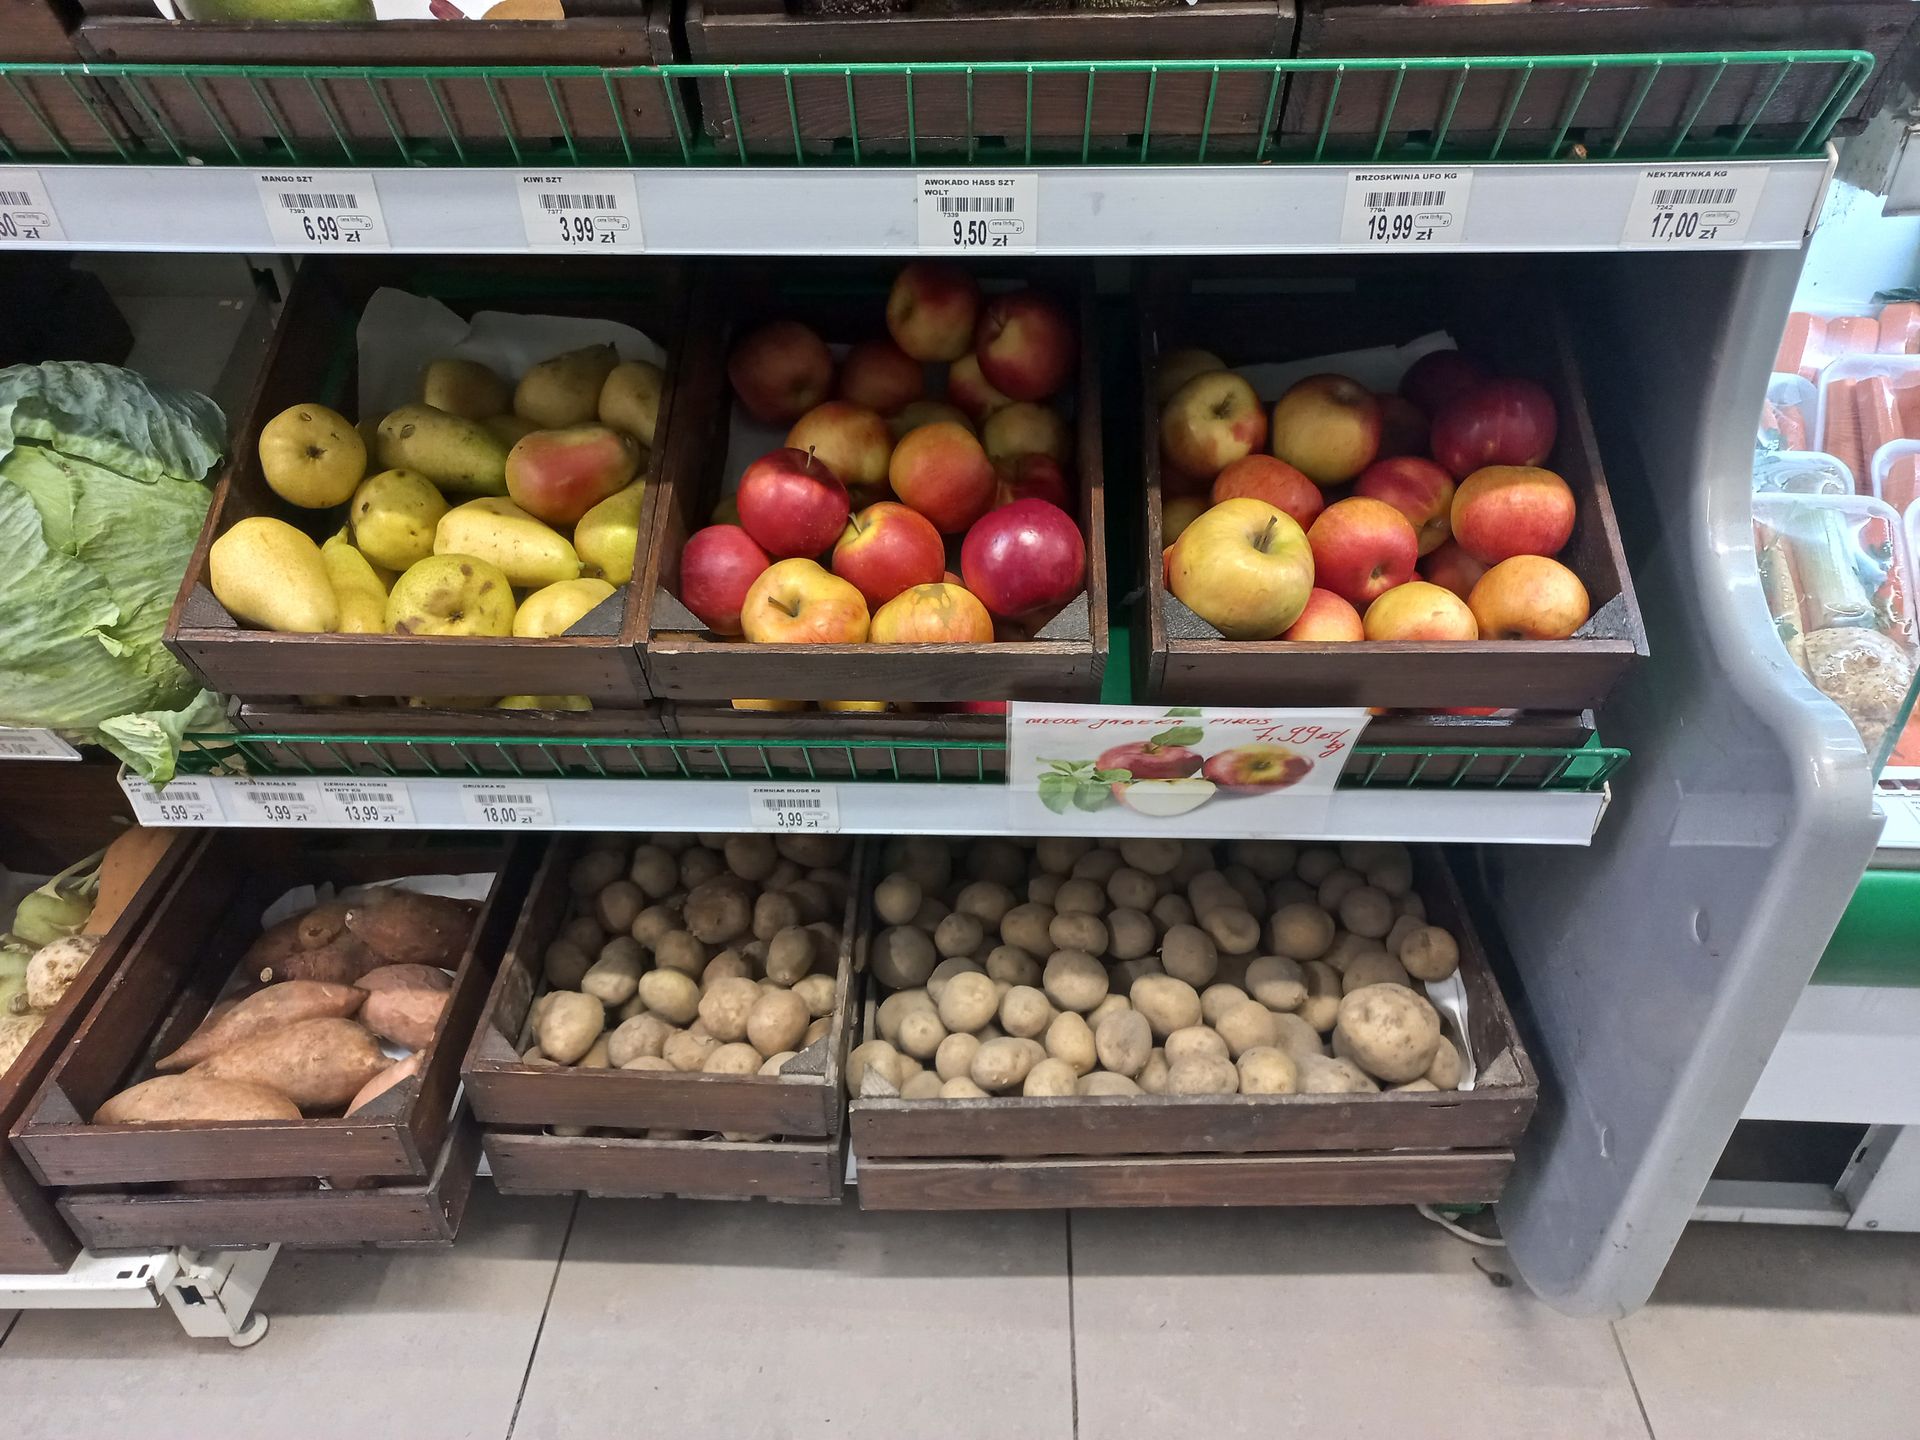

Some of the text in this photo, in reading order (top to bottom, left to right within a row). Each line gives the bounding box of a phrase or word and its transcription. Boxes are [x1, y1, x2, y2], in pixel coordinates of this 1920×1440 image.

[261, 175, 294, 183] MANGO
[1647, 170, 1711, 178] NEKTARYNKA
[303, 216, 339, 244] 6,99
[345, 230, 361, 242] zł
[560, 217, 594, 245] 3,99
[600, 231, 615, 243] zł
[953, 220, 987, 249] 9,50
[992, 235, 1008, 247] zł
[1368, 214, 1413, 243] 19,99
[1416, 228, 1433, 240] zł
[1651, 212, 1699, 241] 17,00
[1698, 227, 1717, 239] zł
[161, 805, 188, 821] 5,99
[264, 805, 291, 821] 3,99
[345, 806, 379, 822] 13,99
[484, 807, 517, 824] 18,00
[777, 812, 803, 828] 3,99
